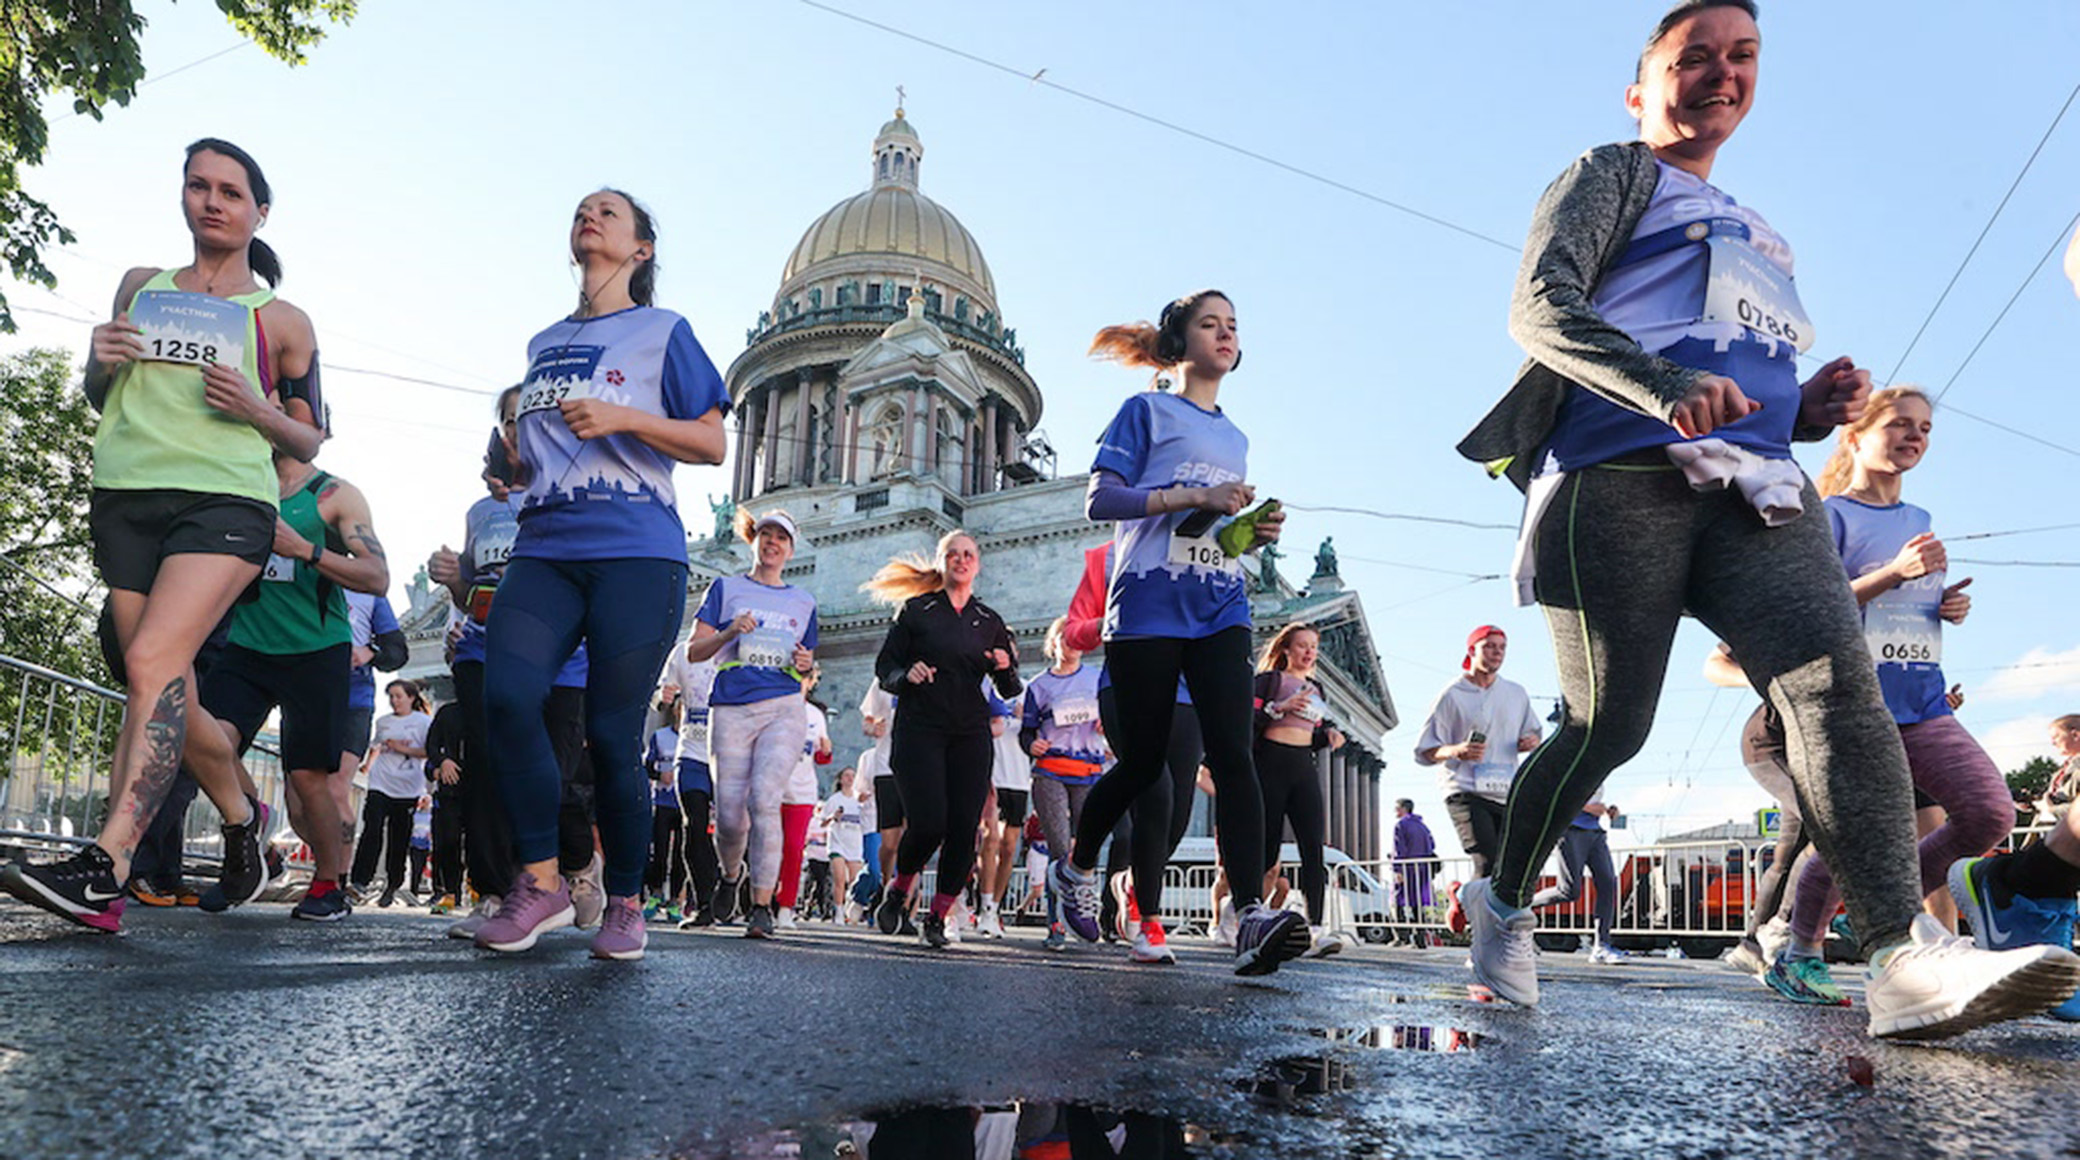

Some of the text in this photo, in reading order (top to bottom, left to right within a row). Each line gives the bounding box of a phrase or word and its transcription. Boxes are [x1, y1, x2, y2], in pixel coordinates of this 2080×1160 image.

[160, 304, 218, 320] УЧАСТНИК
[1737, 297, 1798, 342] 0786
[152, 338, 217, 364] 1258
[522, 387, 570, 410] 0237
[484, 546, 512, 561] 116
[748, 653, 783, 666] 0819
[1881, 643, 1931, 660] 0656
[1063, 711, 1090, 724] 1099
